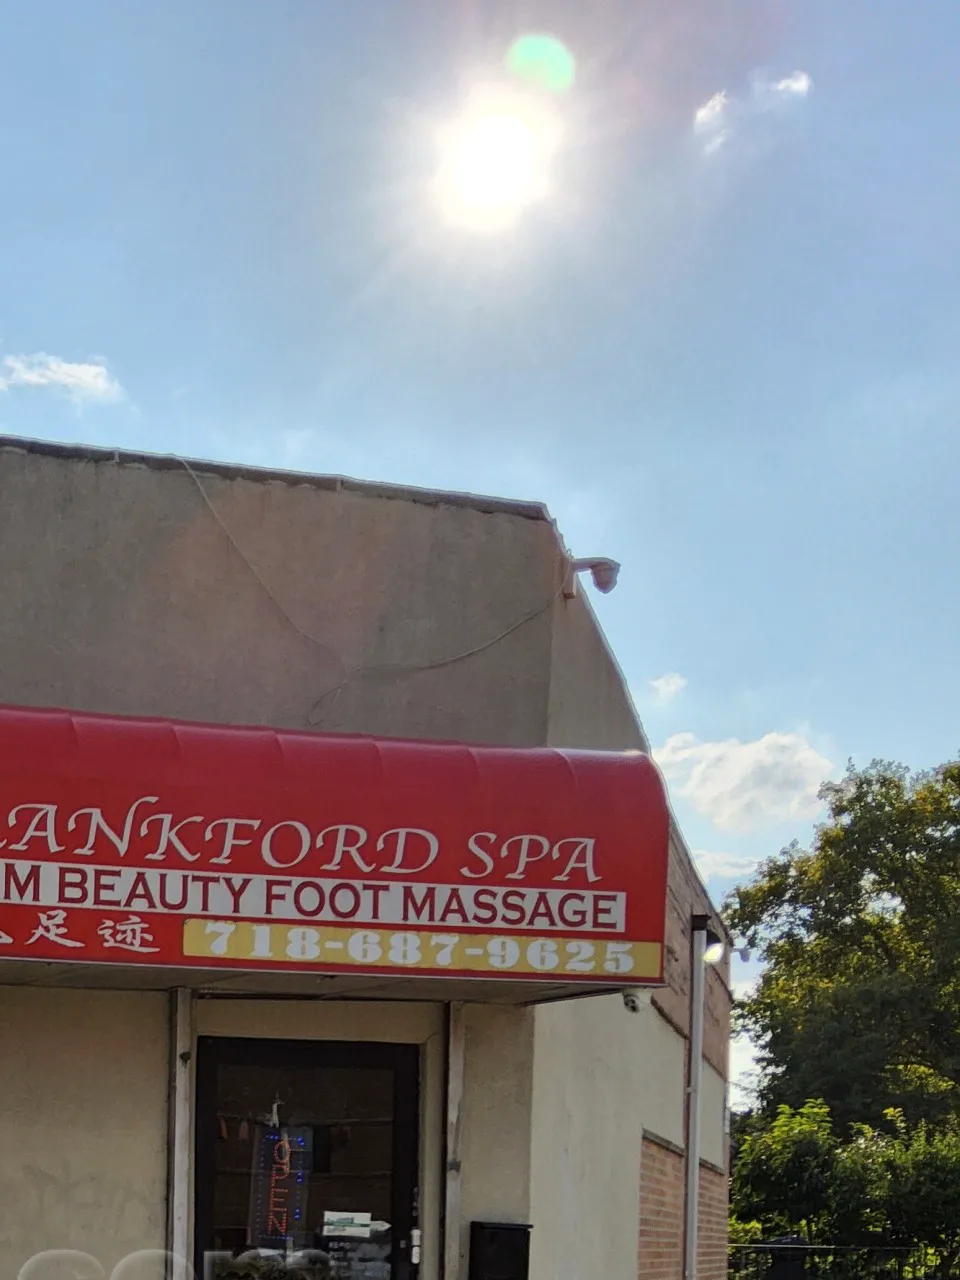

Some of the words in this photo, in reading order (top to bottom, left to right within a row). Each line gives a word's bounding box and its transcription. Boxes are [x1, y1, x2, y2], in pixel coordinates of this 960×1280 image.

[461, 831, 603, 883] SPA
[57, 870, 253, 914] BEAUTY
[265, 879, 390, 920] FOOT
[402, 885, 619, 929] MASSAGE
[204, 920, 635, 974] 718-687-9625
[266, 1140, 291, 1235] OPEN
